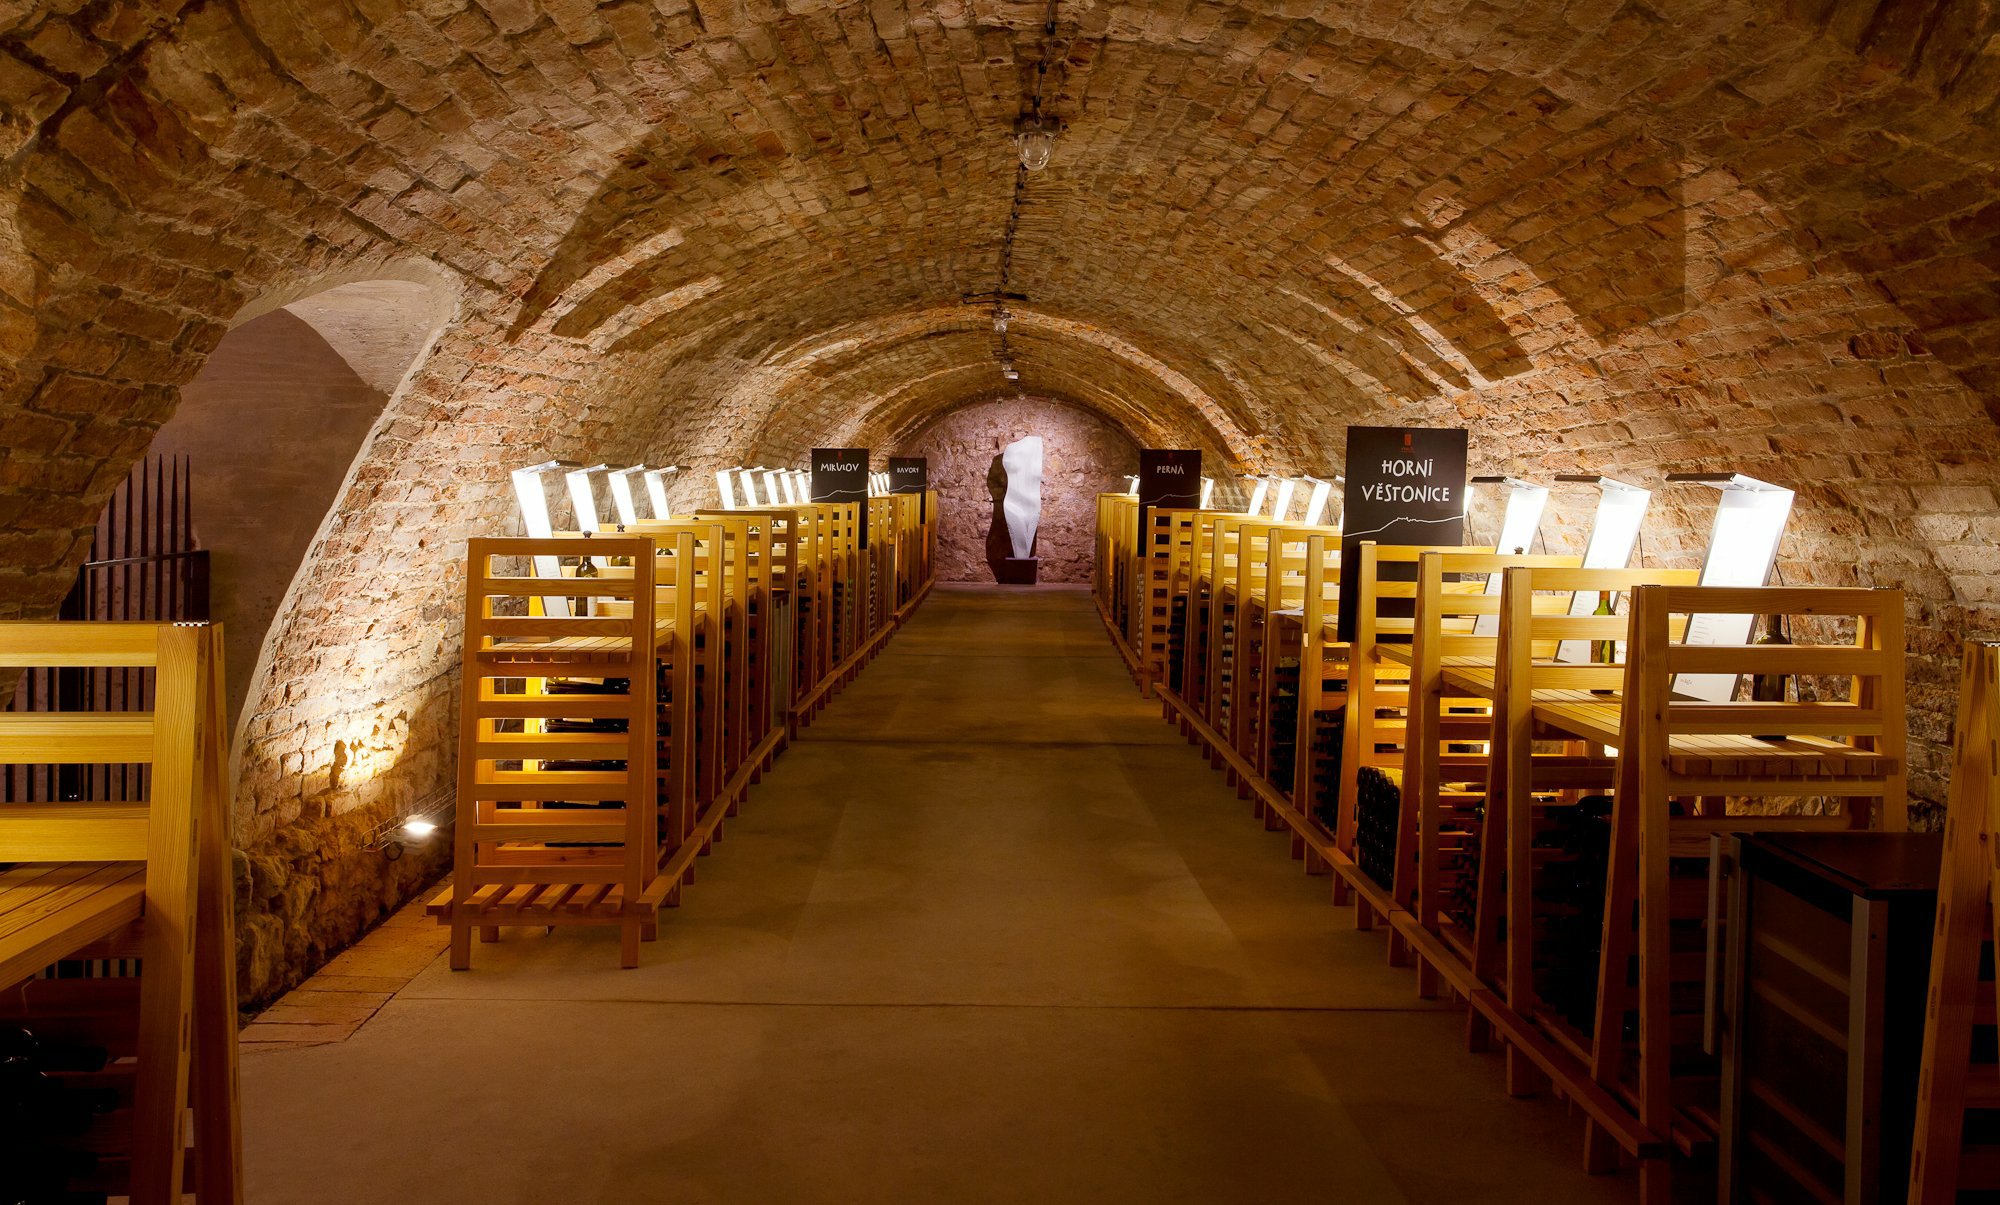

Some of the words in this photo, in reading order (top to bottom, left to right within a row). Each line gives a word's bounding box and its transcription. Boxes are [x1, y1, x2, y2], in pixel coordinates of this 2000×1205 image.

[820, 461, 860, 473] MIKULOV
[896, 466, 920, 474] BAVORY
[1156, 463, 1185, 475] PERNÁ
[1381, 458, 1434, 478] HORNÍ
[1361, 482, 1450, 504] VĚSTONICE
